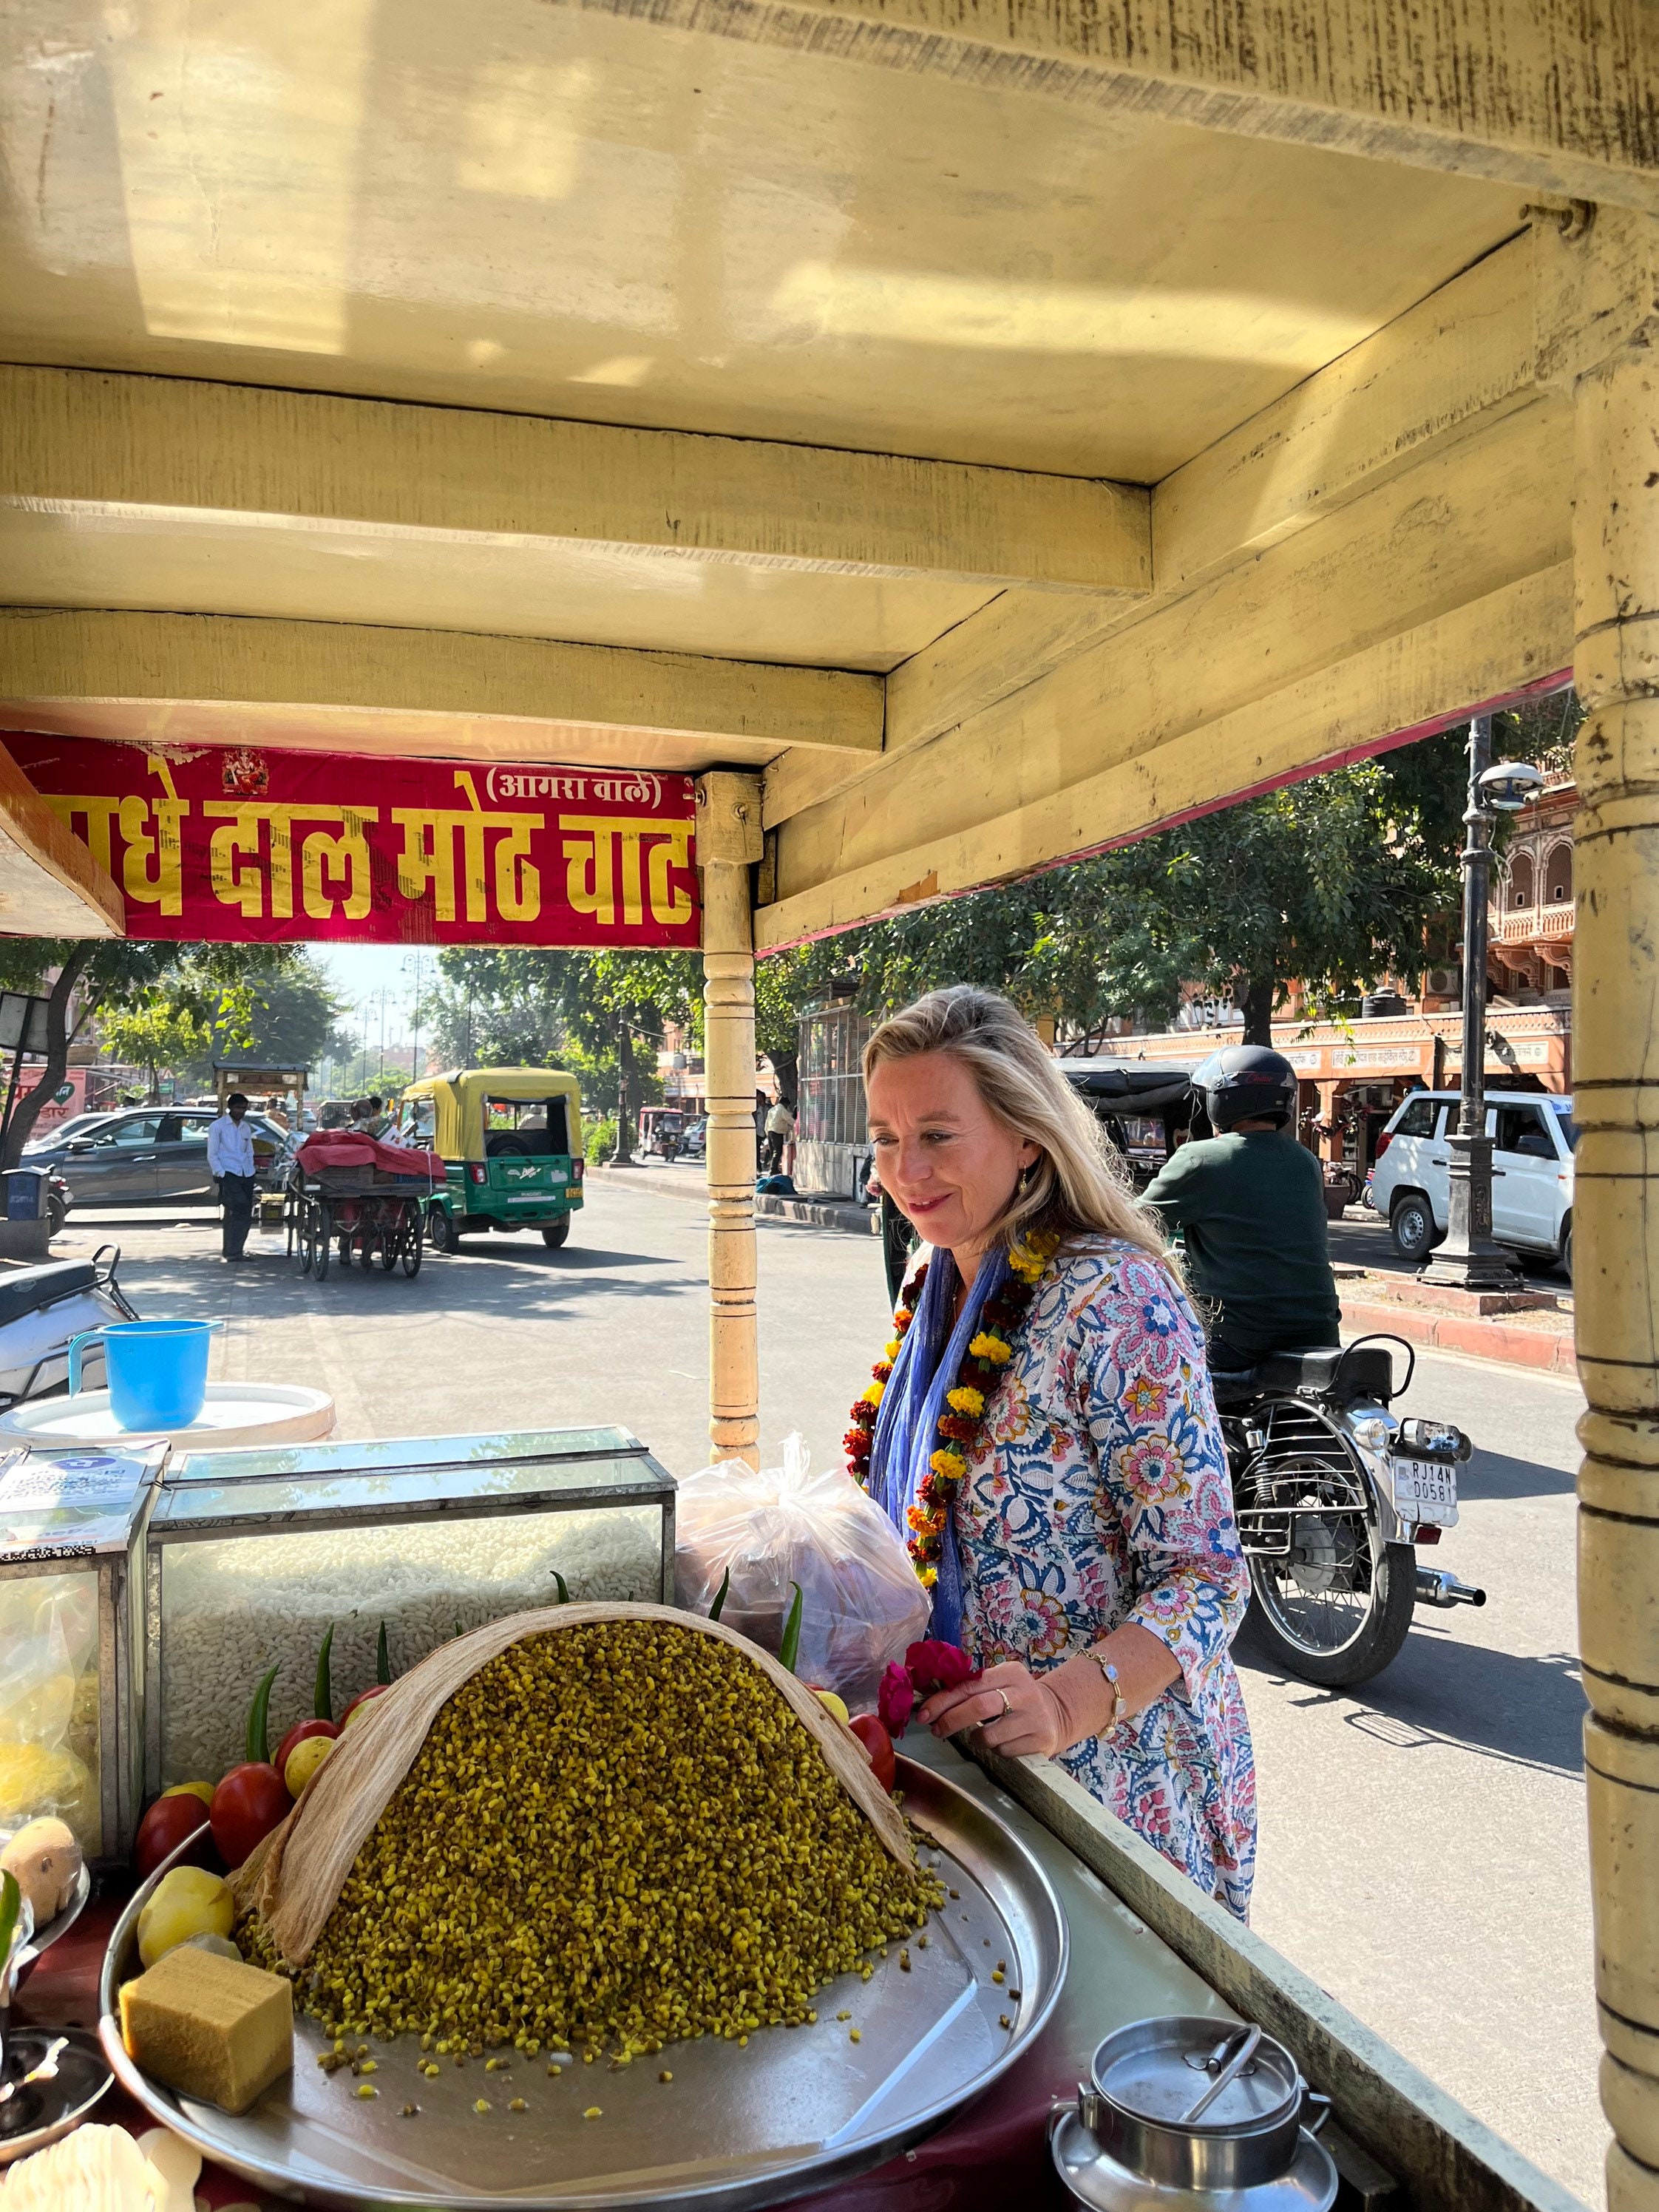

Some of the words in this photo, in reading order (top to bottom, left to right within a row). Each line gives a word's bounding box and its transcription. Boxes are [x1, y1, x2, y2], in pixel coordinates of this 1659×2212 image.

[486, 767, 588, 804] (आगरा
[591, 770, 662, 810] वाले)
[203, 800, 379, 920] दाल
[391, 770, 546, 922] मोठ
[559, 814, 695, 925] चाट
[1414, 1481, 1452, 1502] D0581
